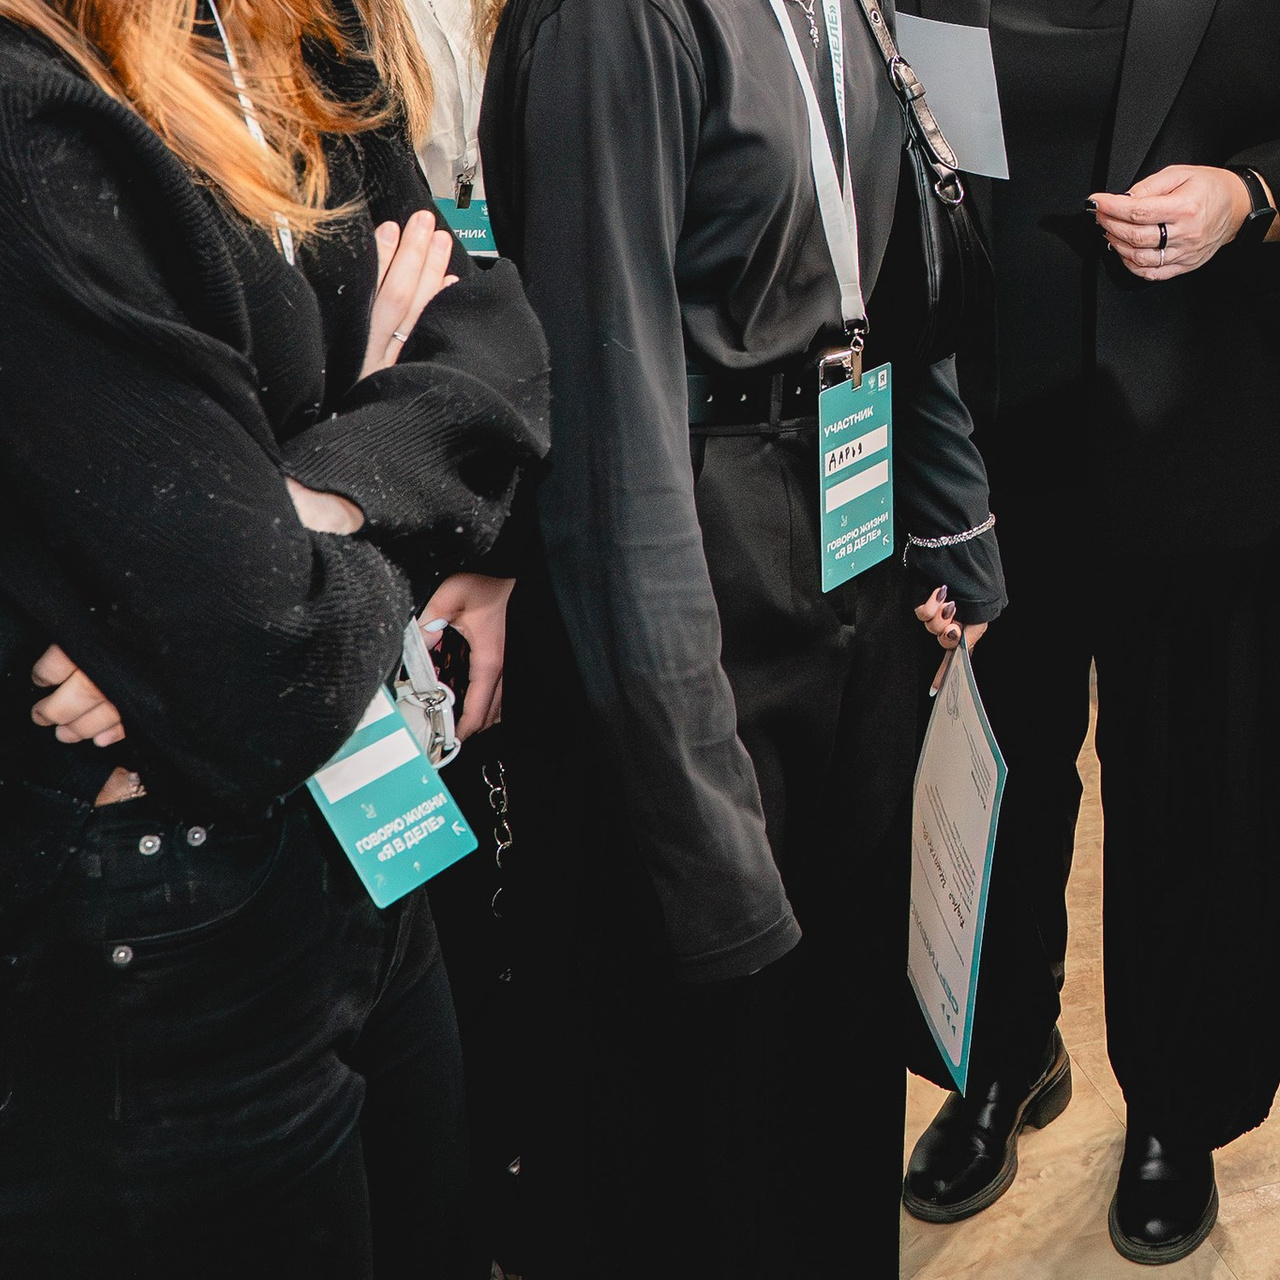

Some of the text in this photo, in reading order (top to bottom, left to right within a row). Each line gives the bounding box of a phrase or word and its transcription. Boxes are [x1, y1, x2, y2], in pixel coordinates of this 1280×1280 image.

[824, 405, 874, 438] УЧАСТНИК
[827, 511, 888, 553] ГОВОРЮ ЖИЗНИ
[835, 528, 882, 560] «Я В ДЕЛЕ»
[355, 792, 448, 854] ГОВОРЮ ЖИЗНИ
[377, 815, 445, 862] «Я В ДЕЛЕ»
